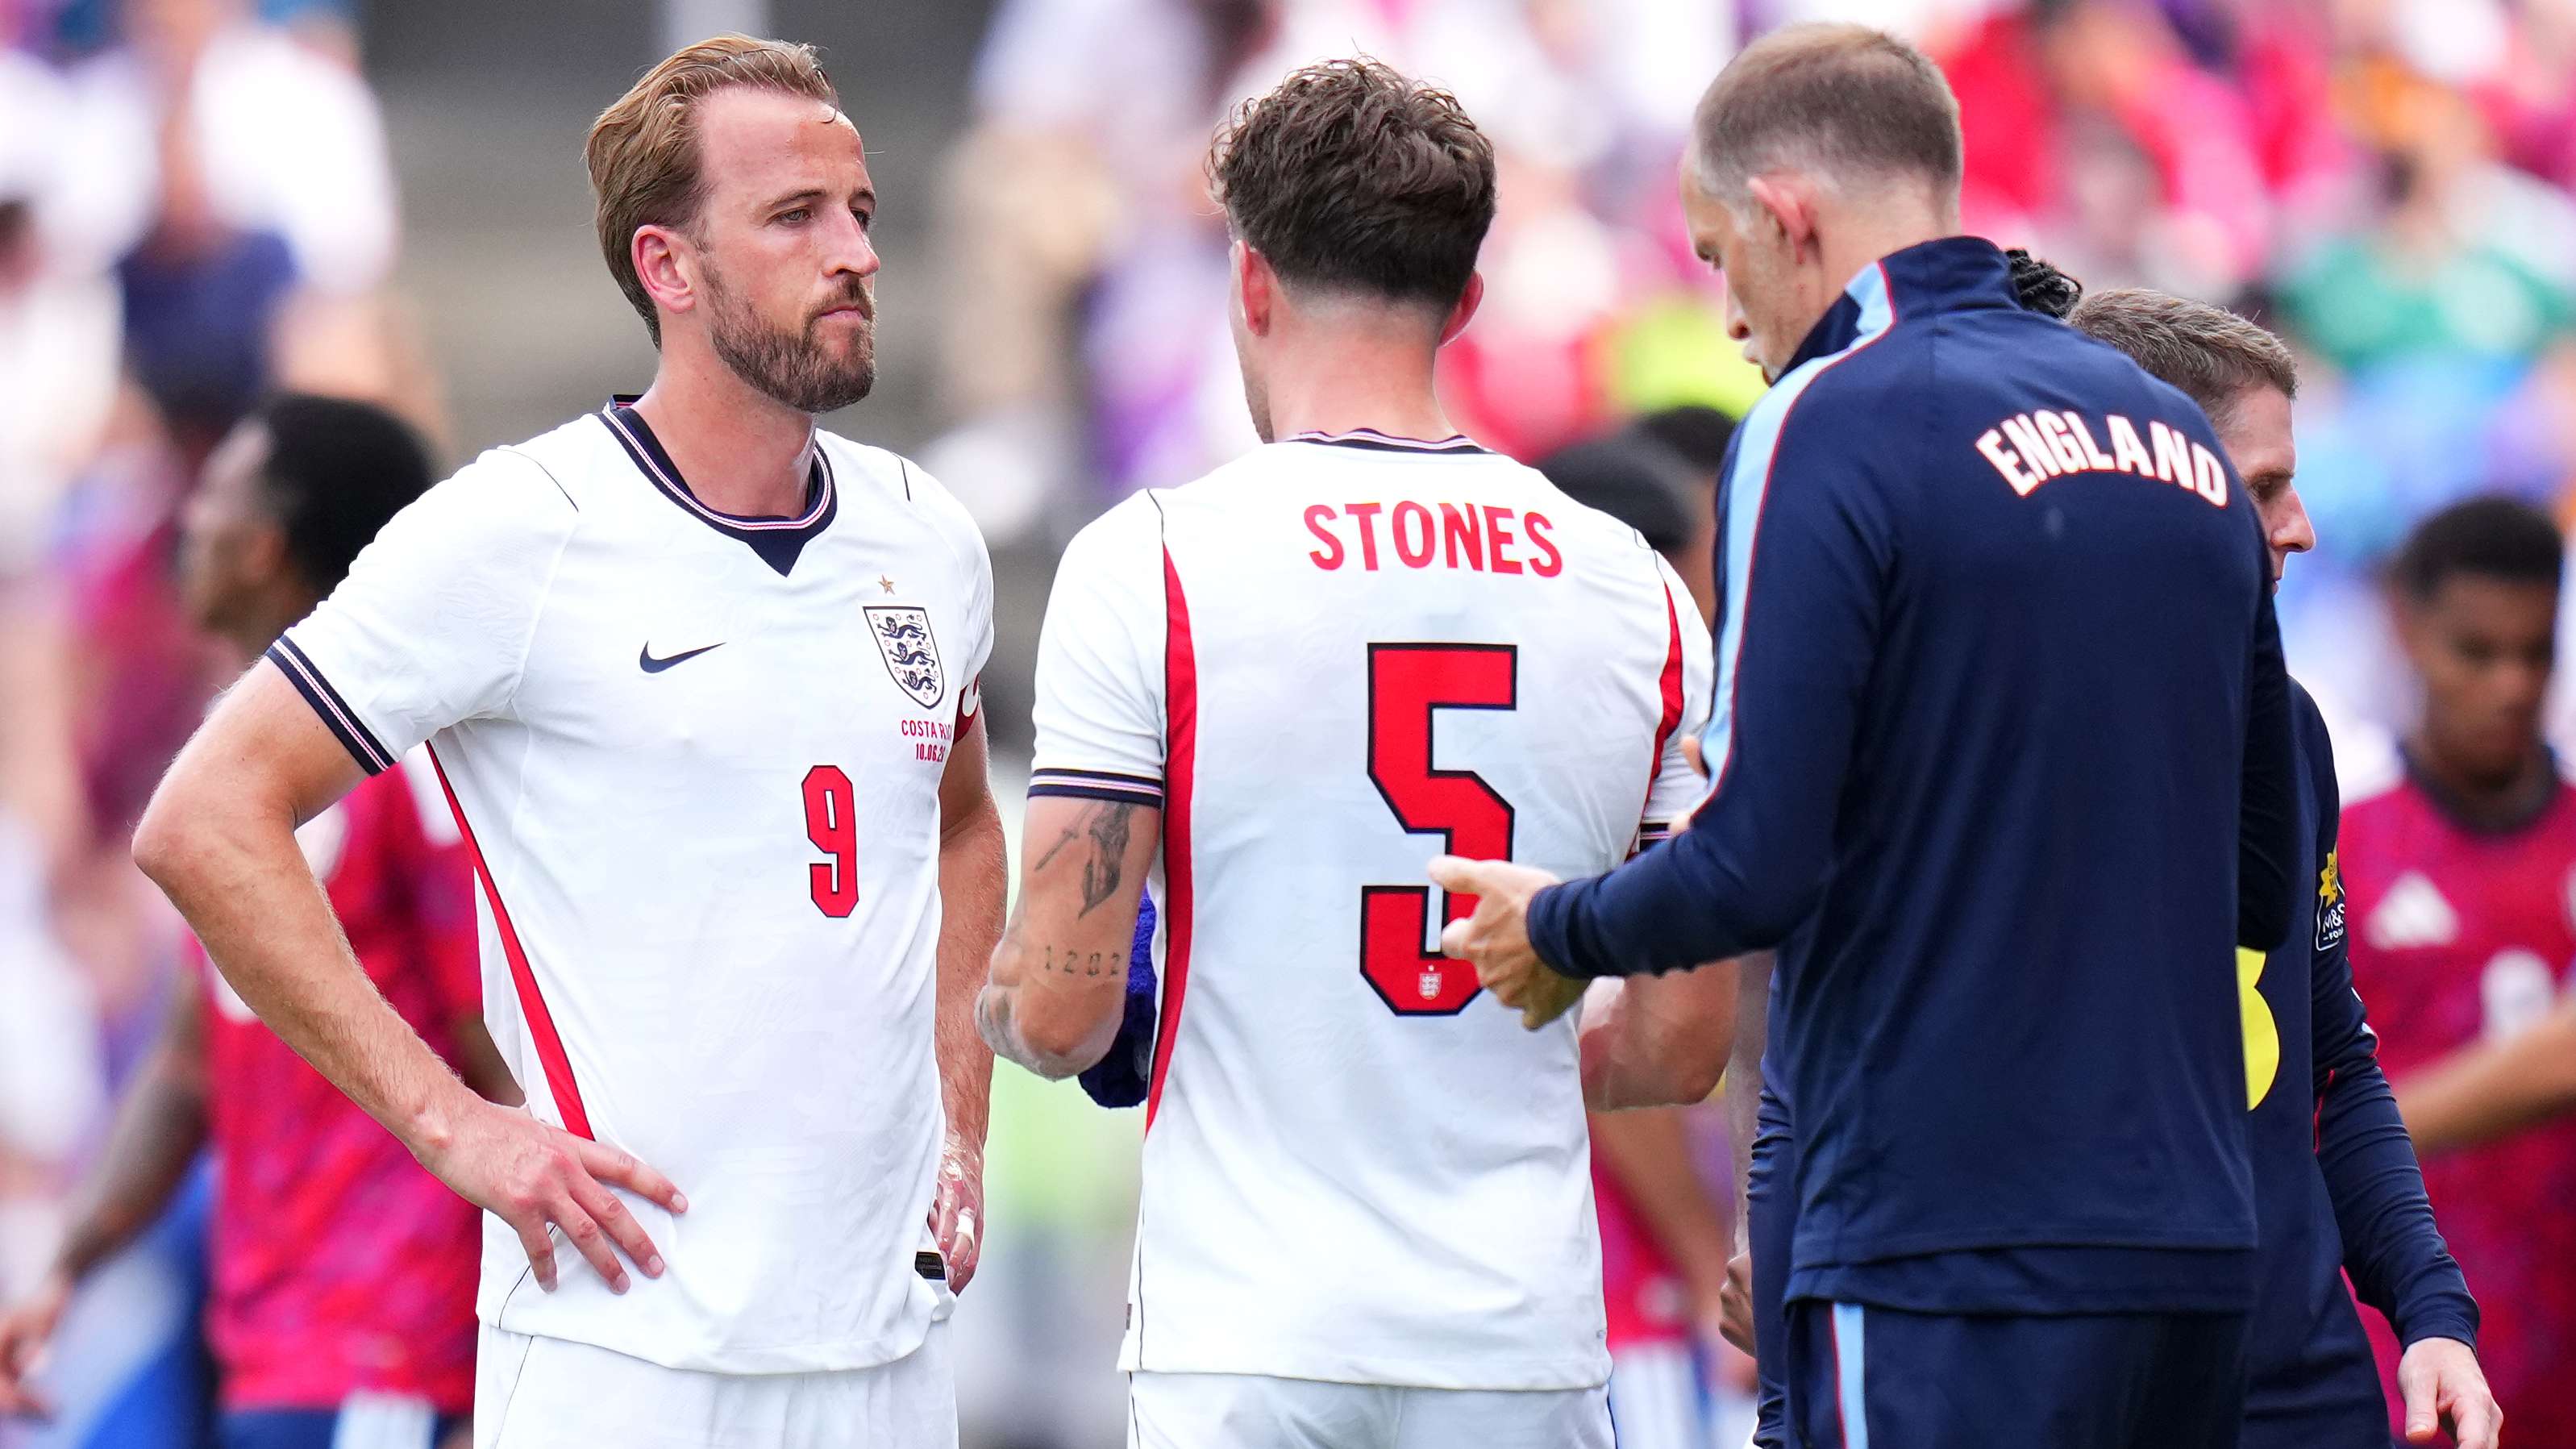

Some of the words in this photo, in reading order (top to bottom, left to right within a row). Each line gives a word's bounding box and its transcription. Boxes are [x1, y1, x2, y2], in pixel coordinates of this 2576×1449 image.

[1975, 409, 2228, 508] ENGLAND
[1303, 500, 1563, 577] STONES
[901, 719, 938, 739] COSTA
[801, 765, 859, 918] 9
[1359, 643, 1517, 1017] 5
